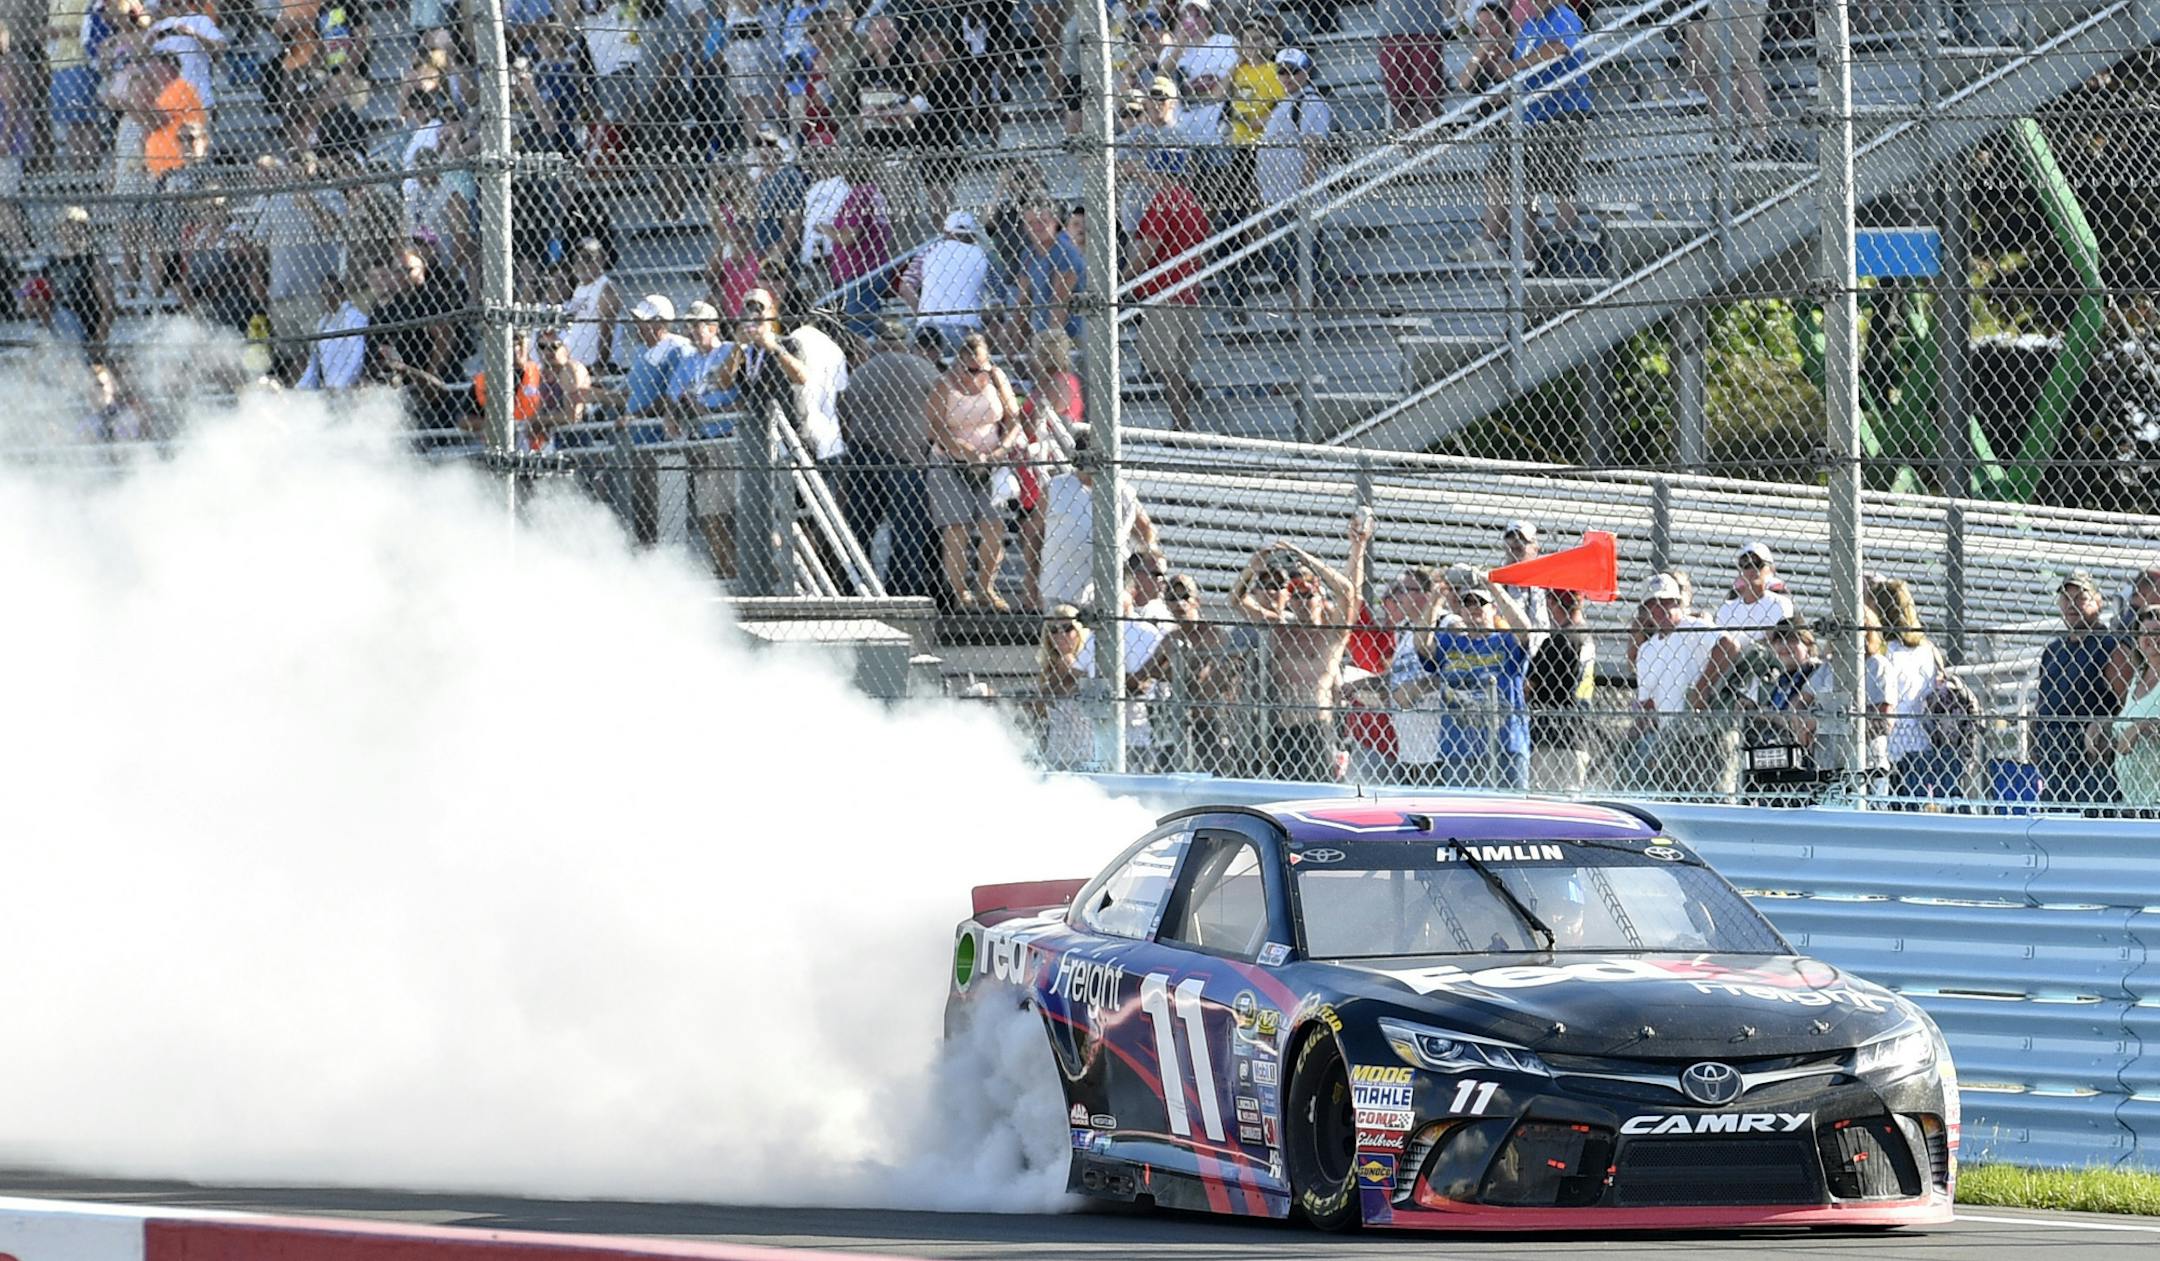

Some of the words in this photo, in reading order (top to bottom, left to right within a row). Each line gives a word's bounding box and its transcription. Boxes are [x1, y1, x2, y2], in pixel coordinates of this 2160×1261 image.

[1436, 844, 1564, 862] HAMLIN
[1049, 948, 1123, 1019] Freight
[1140, 972, 1226, 1142] 11
[1350, 1065, 1415, 1083] MOOG
[1354, 1086, 1411, 1106] MAHLE
[1449, 1079, 1499, 1115] 11
[1358, 1111, 1398, 1125] COMP
[1619, 1112, 1811, 1134] CAMRY
[1358, 1132, 1405, 1149] Edelbrock
[1360, 1166, 1392, 1177] SUNOCO
